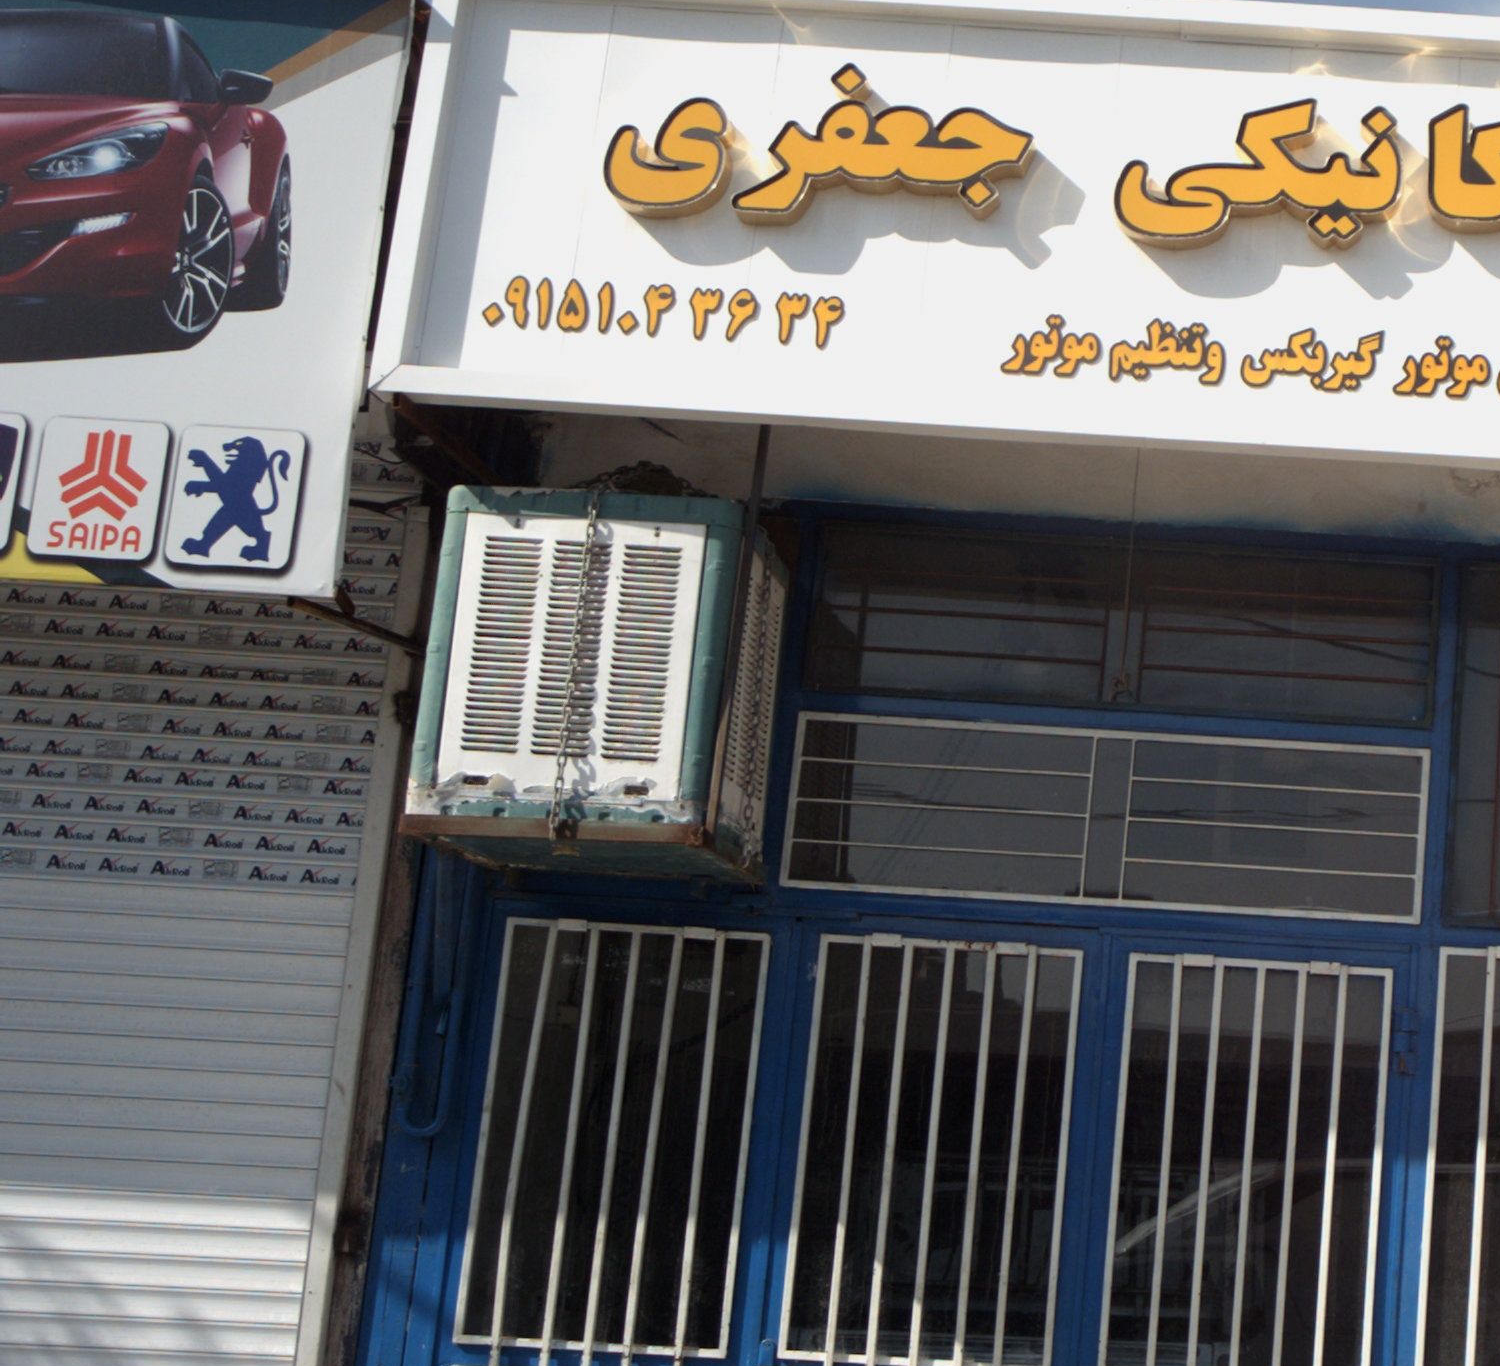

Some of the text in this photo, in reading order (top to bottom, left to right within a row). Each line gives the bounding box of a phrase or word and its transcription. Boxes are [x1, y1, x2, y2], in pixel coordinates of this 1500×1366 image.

[603, 63, 1034, 225] جعفری
[1001, 314, 1101, 377] موتور
[1241, 328, 1385, 392] گیربکس
[1393, 335, 1491, 398] موتور
[47, 521, 142, 553] SAIPA
